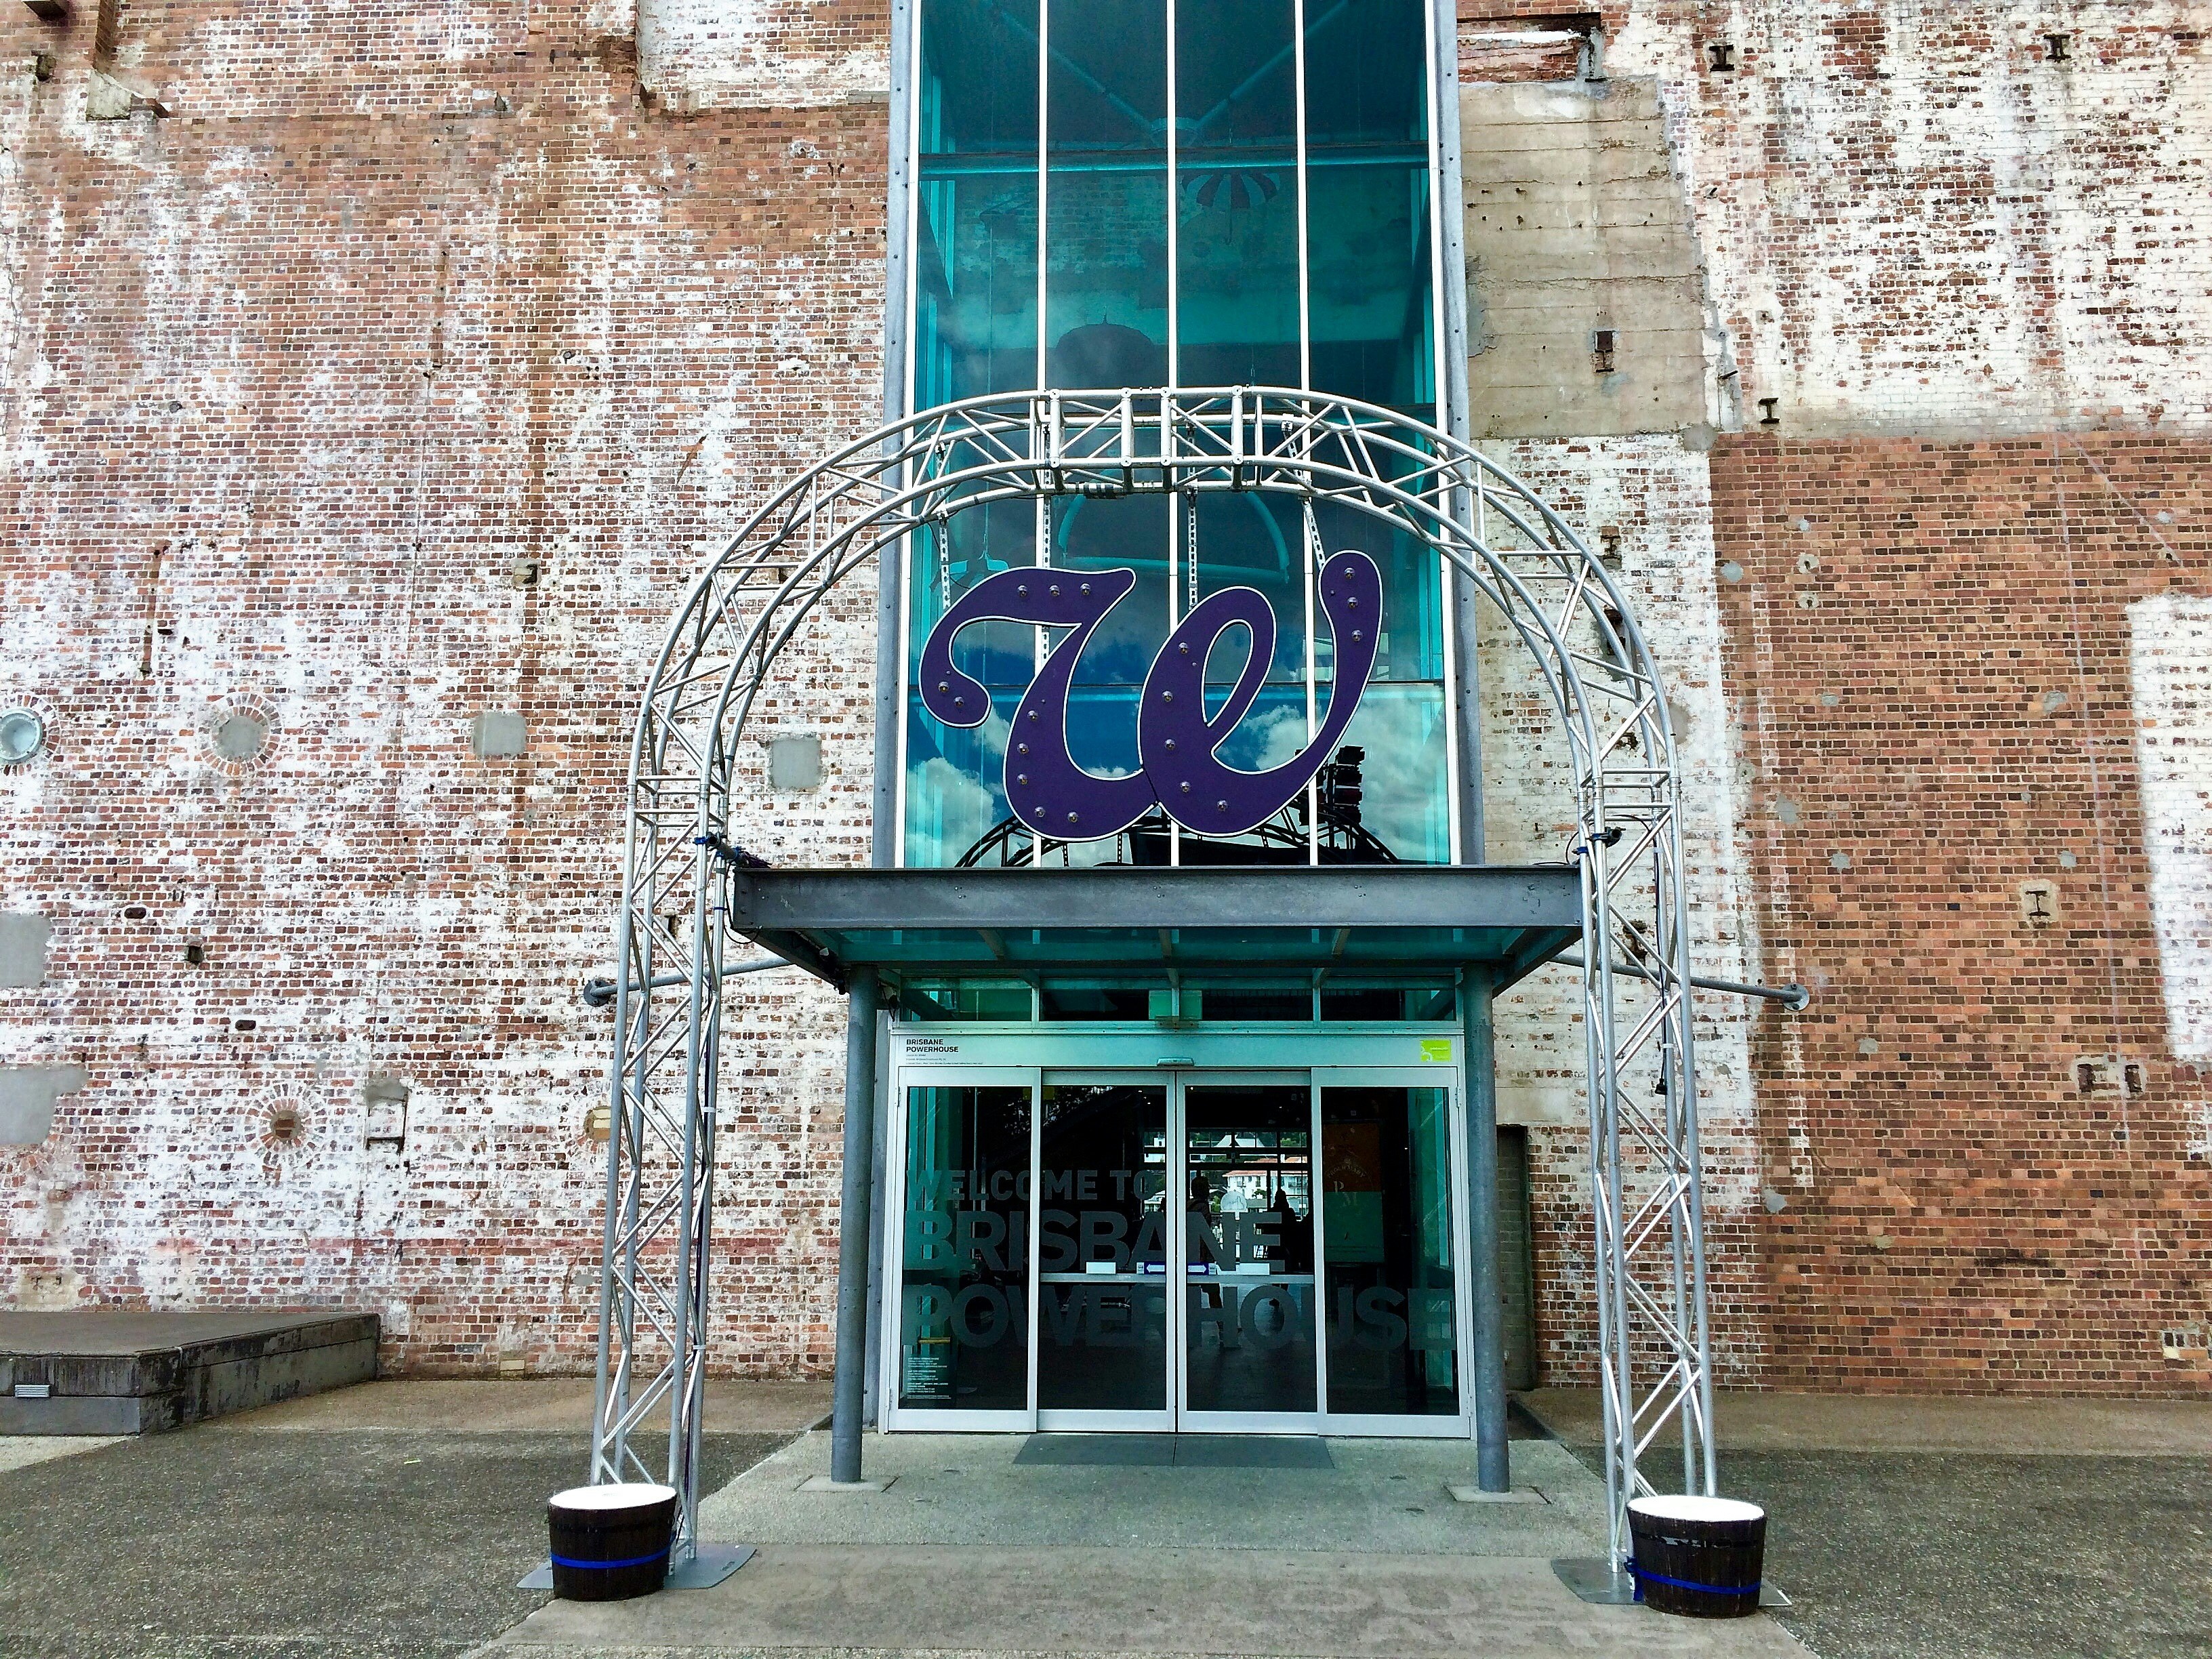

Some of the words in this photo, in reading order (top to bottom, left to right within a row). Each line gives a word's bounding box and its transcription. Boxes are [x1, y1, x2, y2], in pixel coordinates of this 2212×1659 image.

[907, 1170, 1099, 1201] WELCOME
[1109, 1170, 1153, 1201] TO
[903, 1209, 1286, 1272] BRISBANE
[902, 1283, 1457, 1349] POWERHOUSE
